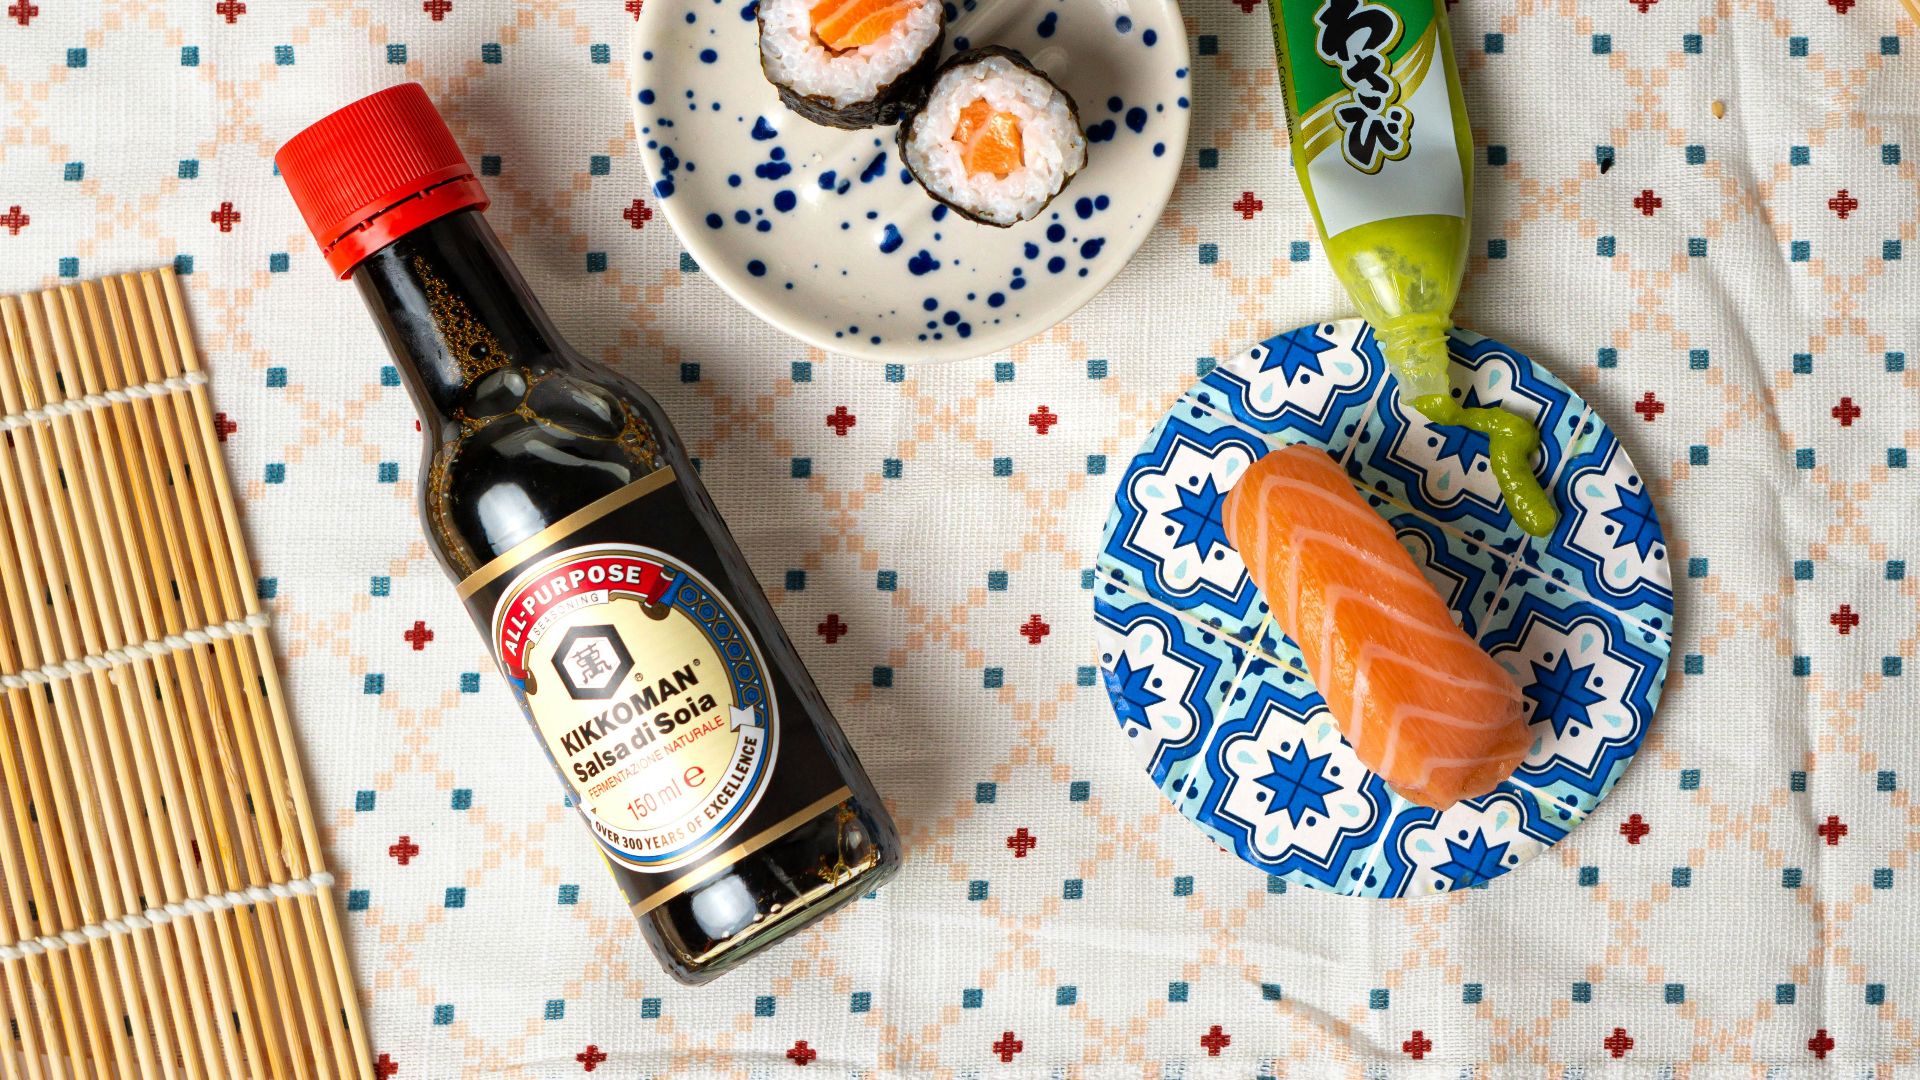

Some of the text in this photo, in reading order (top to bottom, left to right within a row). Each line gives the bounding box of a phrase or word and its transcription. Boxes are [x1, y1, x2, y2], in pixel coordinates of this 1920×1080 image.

[1272, 23, 1283, 63] Foods
[1279, 66, 1294, 144] Corporation
[1317, 0, 1401, 167] わさび
[504, 564, 641, 656] ALL-PURPOSE
[533, 593, 599, 636] SEASONING
[560, 664, 699, 757] KIKKOMAN
[573, 693, 718, 783] Salsa di Soia
[588, 715, 725, 800] FERMENTAZIONE NATURALE
[595, 736, 758, 850] OVER 300 YEARS OF EXCELLENCE
[626, 793, 658, 822] 150
[657, 778, 683, 806] ml
